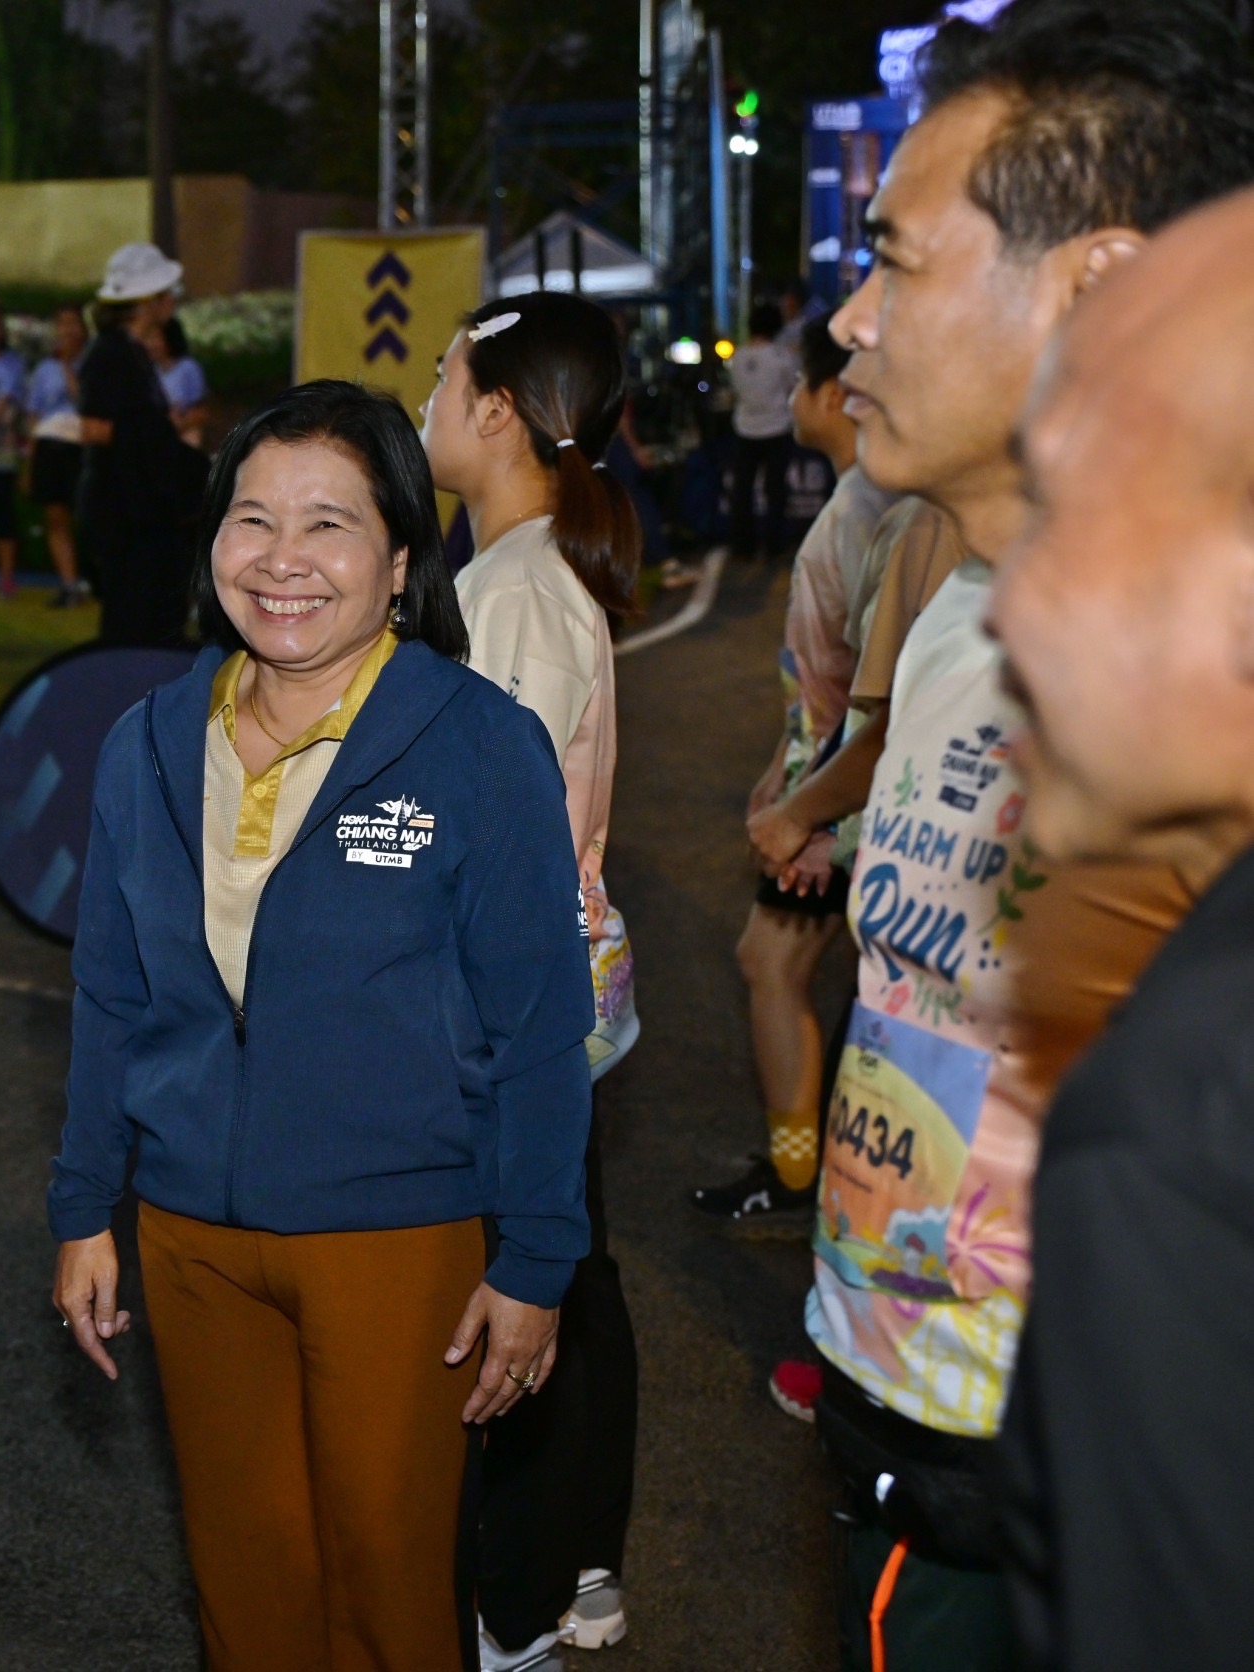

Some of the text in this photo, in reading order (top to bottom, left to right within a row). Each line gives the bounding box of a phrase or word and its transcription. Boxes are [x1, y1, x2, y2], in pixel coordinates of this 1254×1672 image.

[338, 814, 369, 825] HOKA
[336, 825, 433, 846] CHIANG MAI
[338, 840, 399, 851] THAILAND
[870, 806, 1008, 885] WARM UP
[351, 851, 403, 865] BY UTMB
[858, 862, 967, 982] Run
